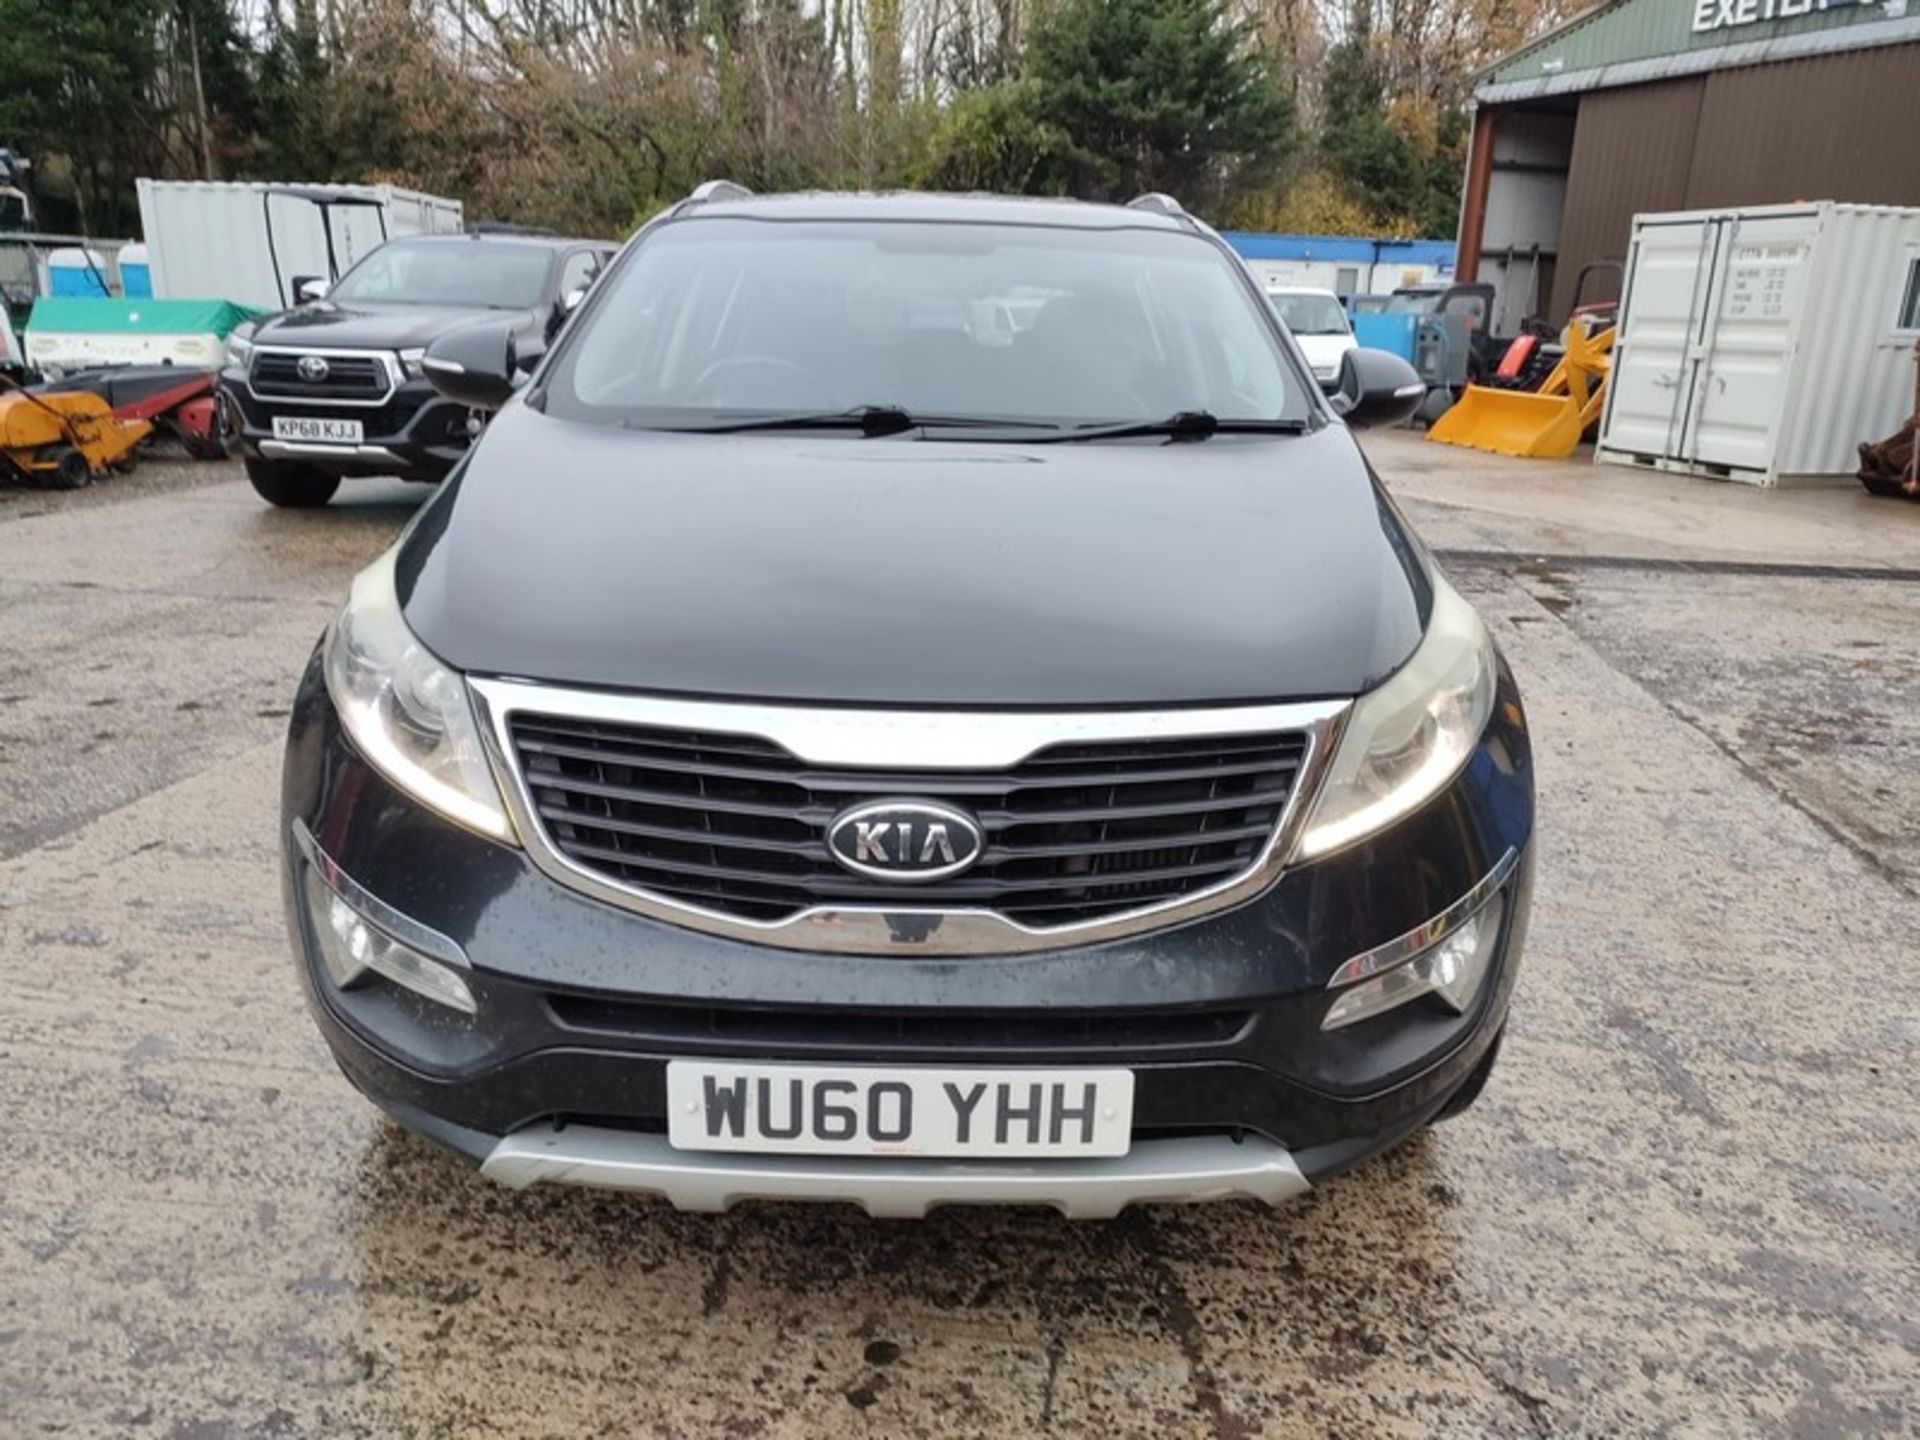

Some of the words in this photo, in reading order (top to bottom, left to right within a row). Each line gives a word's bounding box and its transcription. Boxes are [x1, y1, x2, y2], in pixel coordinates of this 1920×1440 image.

[278, 420, 320, 438] KP68
[323, 421, 357, 439] KJJ
[854, 821, 957, 863] KIA
[702, 1075, 913, 1142] WU60
[942, 1081, 1098, 1144] YHH
